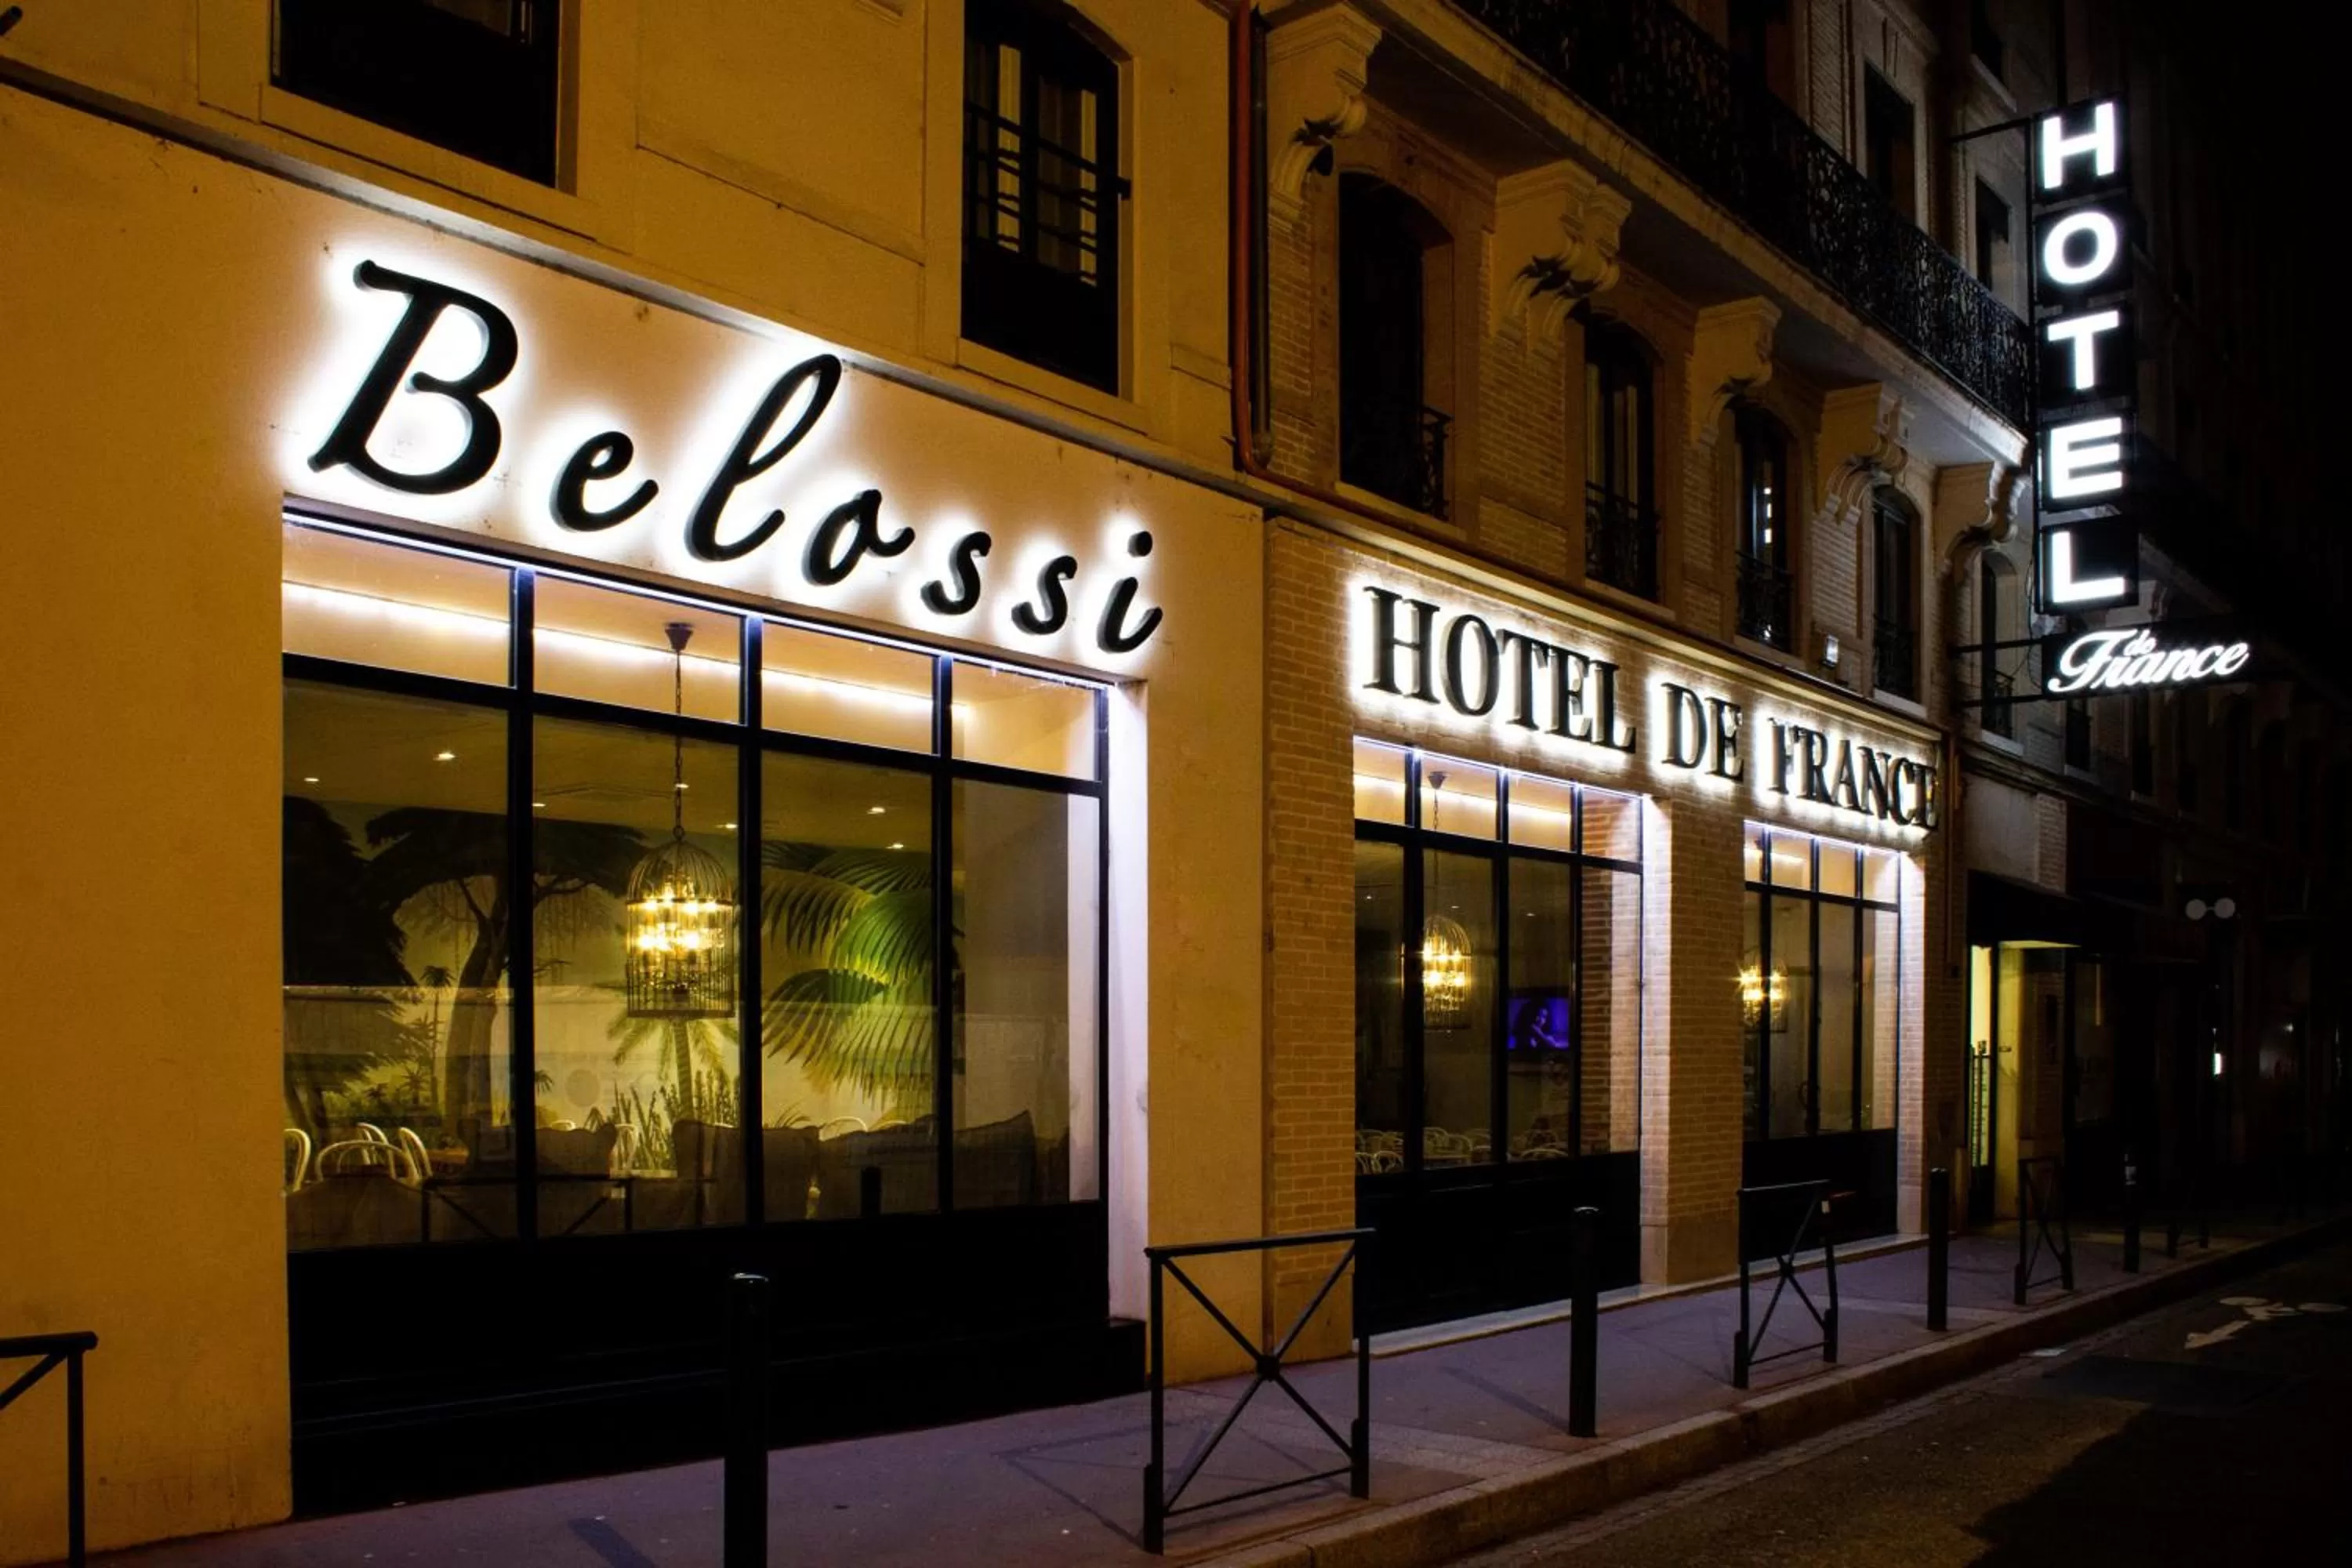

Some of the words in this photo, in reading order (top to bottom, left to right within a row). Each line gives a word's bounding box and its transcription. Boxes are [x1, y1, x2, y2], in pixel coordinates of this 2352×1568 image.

[307, 259, 1164, 654] Belossi
[2042, 101, 2125, 604] HOTEL
[1363, 586, 1637, 754] HOTEL
[1661, 681, 1745, 782] DE
[1767, 717, 1940, 831] FRANCE
[2047, 629, 2249, 692] France
[2123, 629, 2157, 656] de
